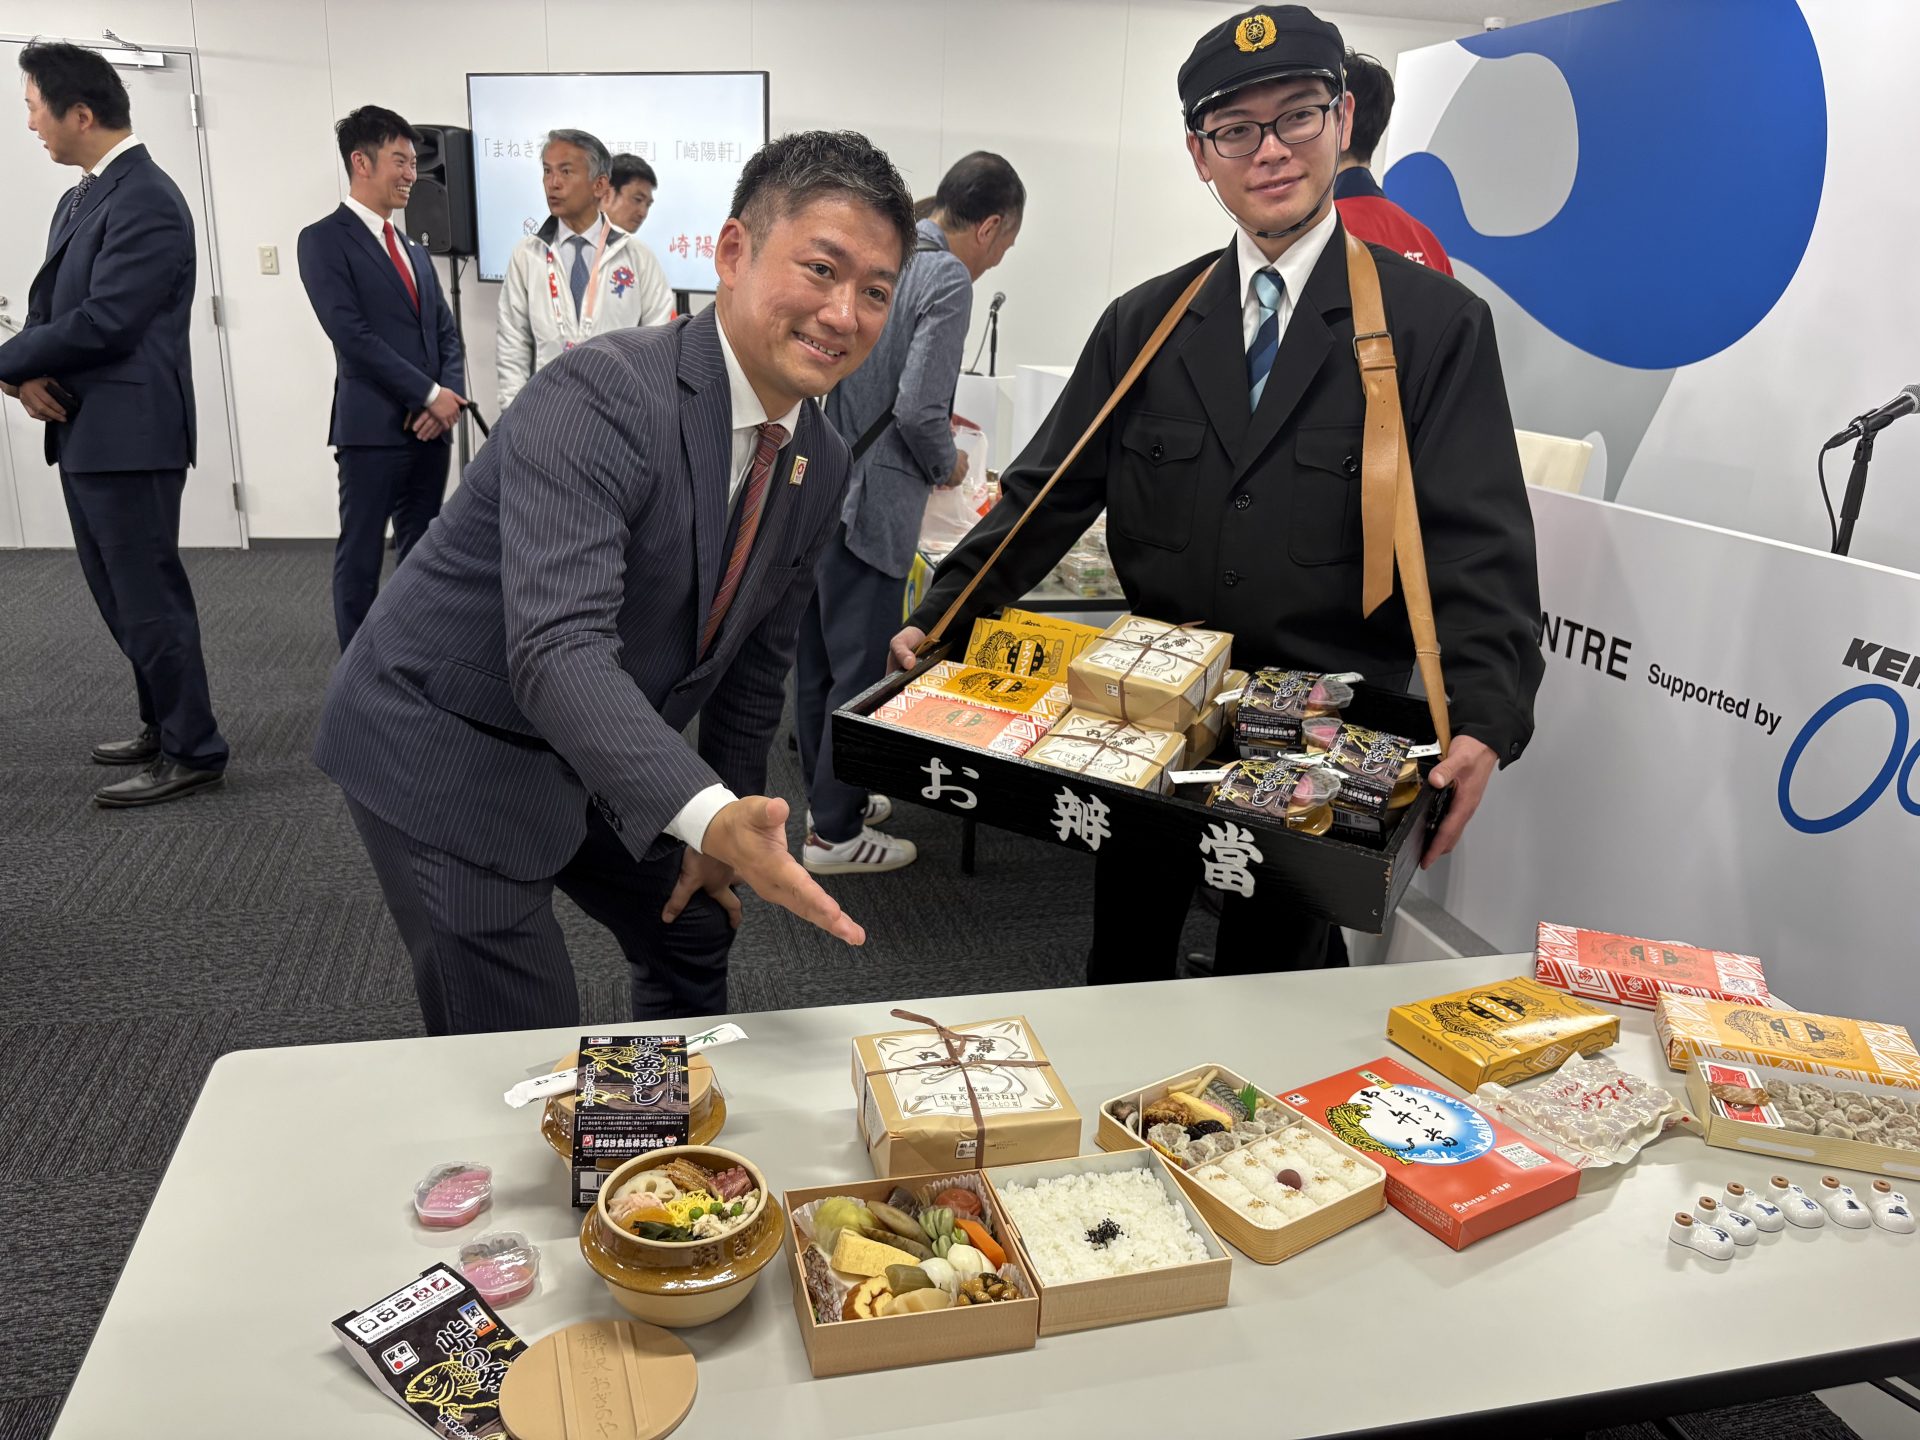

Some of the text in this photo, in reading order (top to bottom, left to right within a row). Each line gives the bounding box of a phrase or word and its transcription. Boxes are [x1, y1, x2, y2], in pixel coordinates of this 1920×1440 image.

[1647, 663, 1750, 719] Supported
[1754, 703, 1782, 735] by
[464, 1304, 490, 1331] 関西
